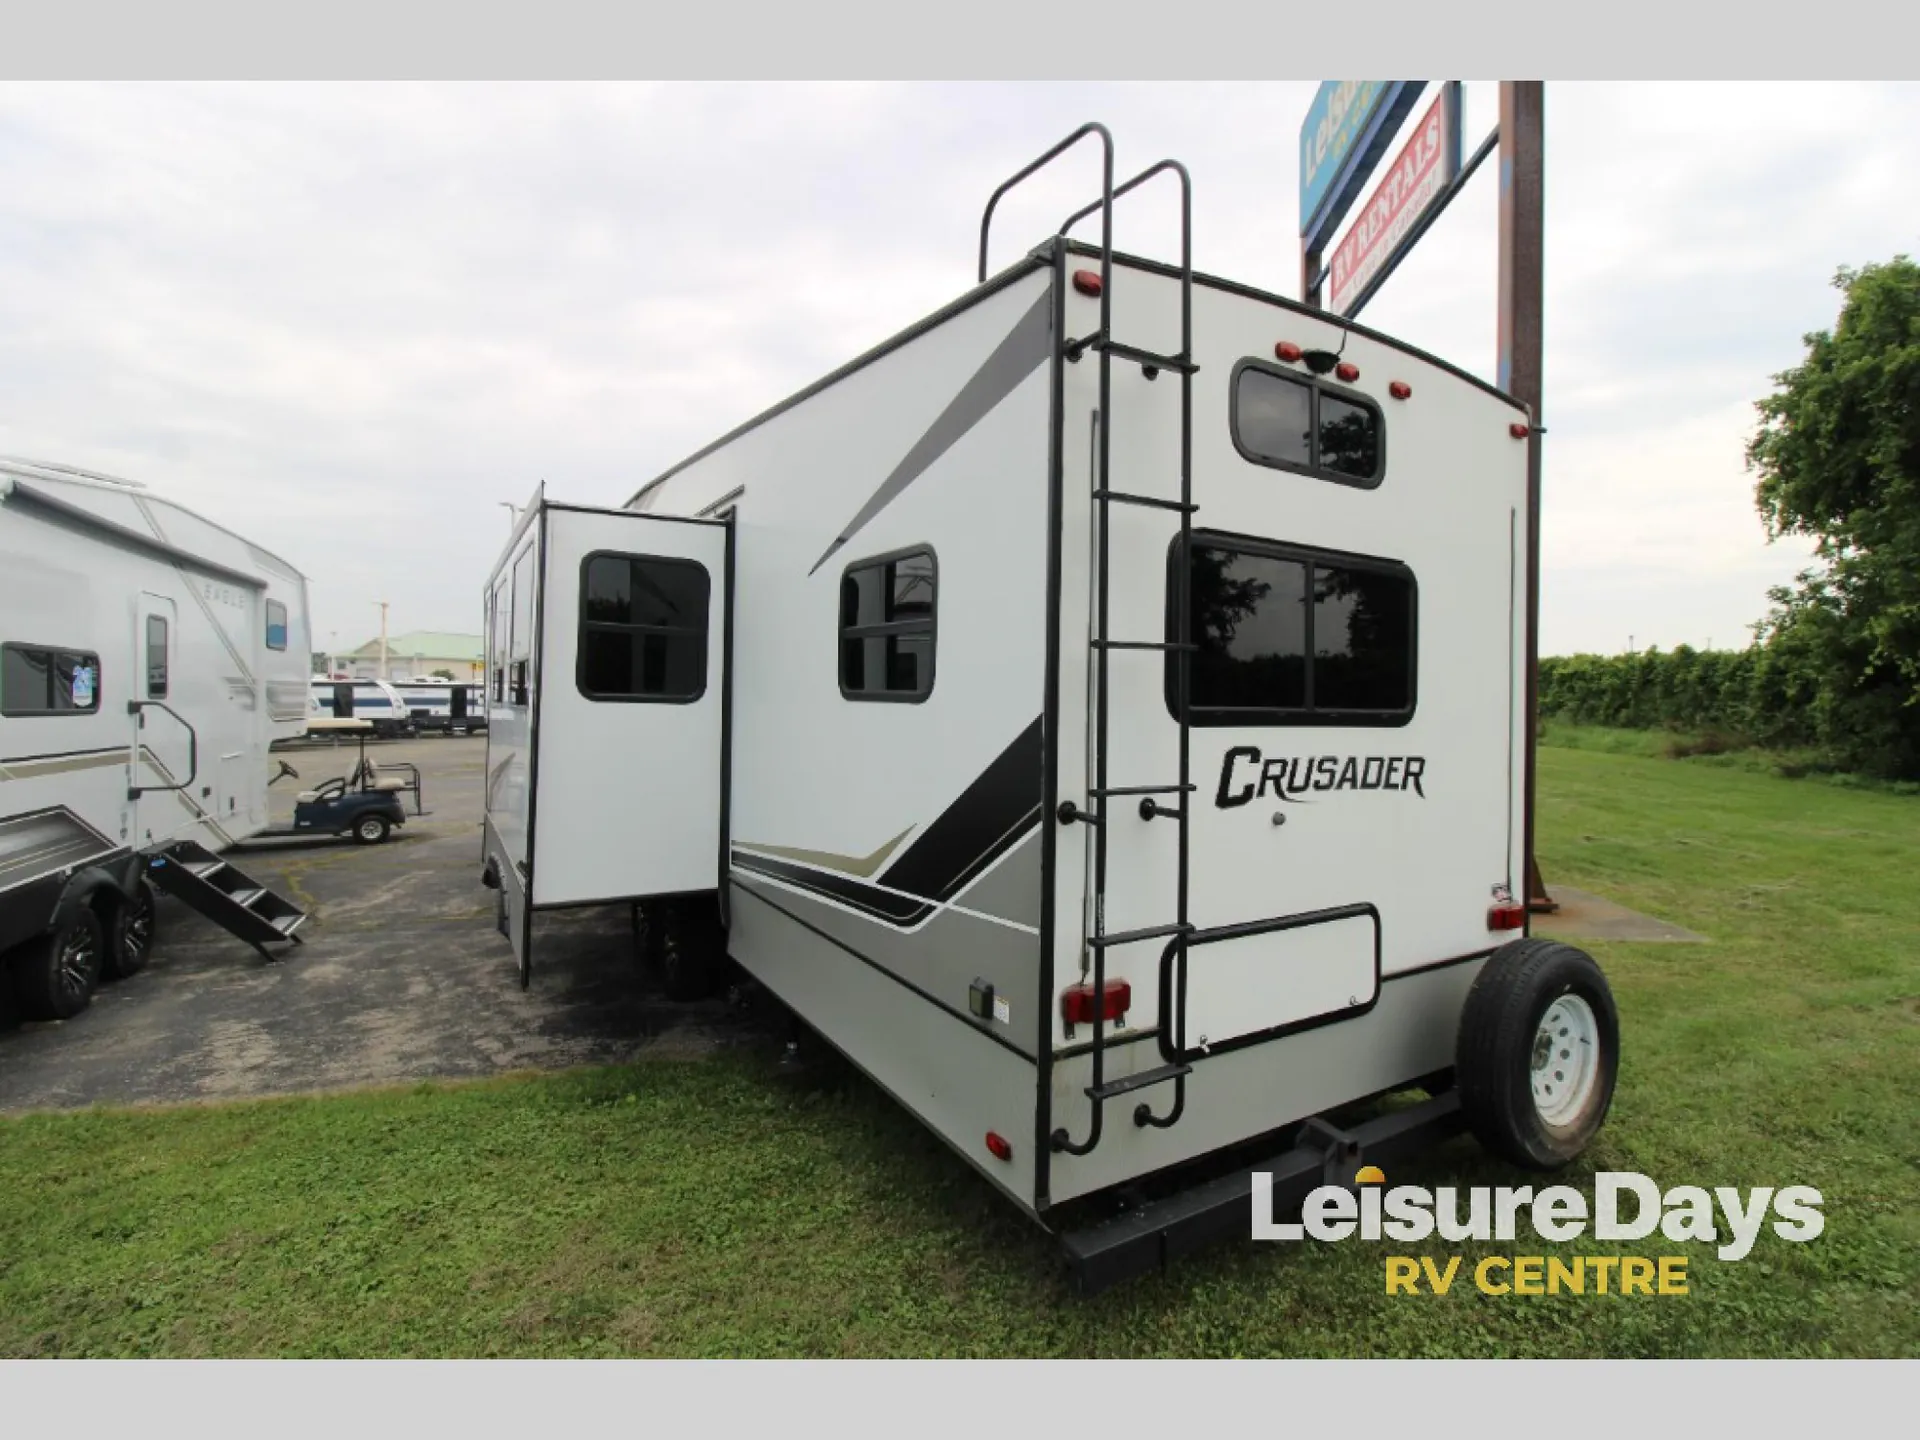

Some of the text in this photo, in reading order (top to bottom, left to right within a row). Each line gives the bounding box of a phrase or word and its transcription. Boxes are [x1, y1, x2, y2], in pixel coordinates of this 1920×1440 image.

[1334, 235, 1355, 288] RV
[1357, 115, 1438, 257] RENTALS
[1215, 745, 1426, 809] CRUSADER
